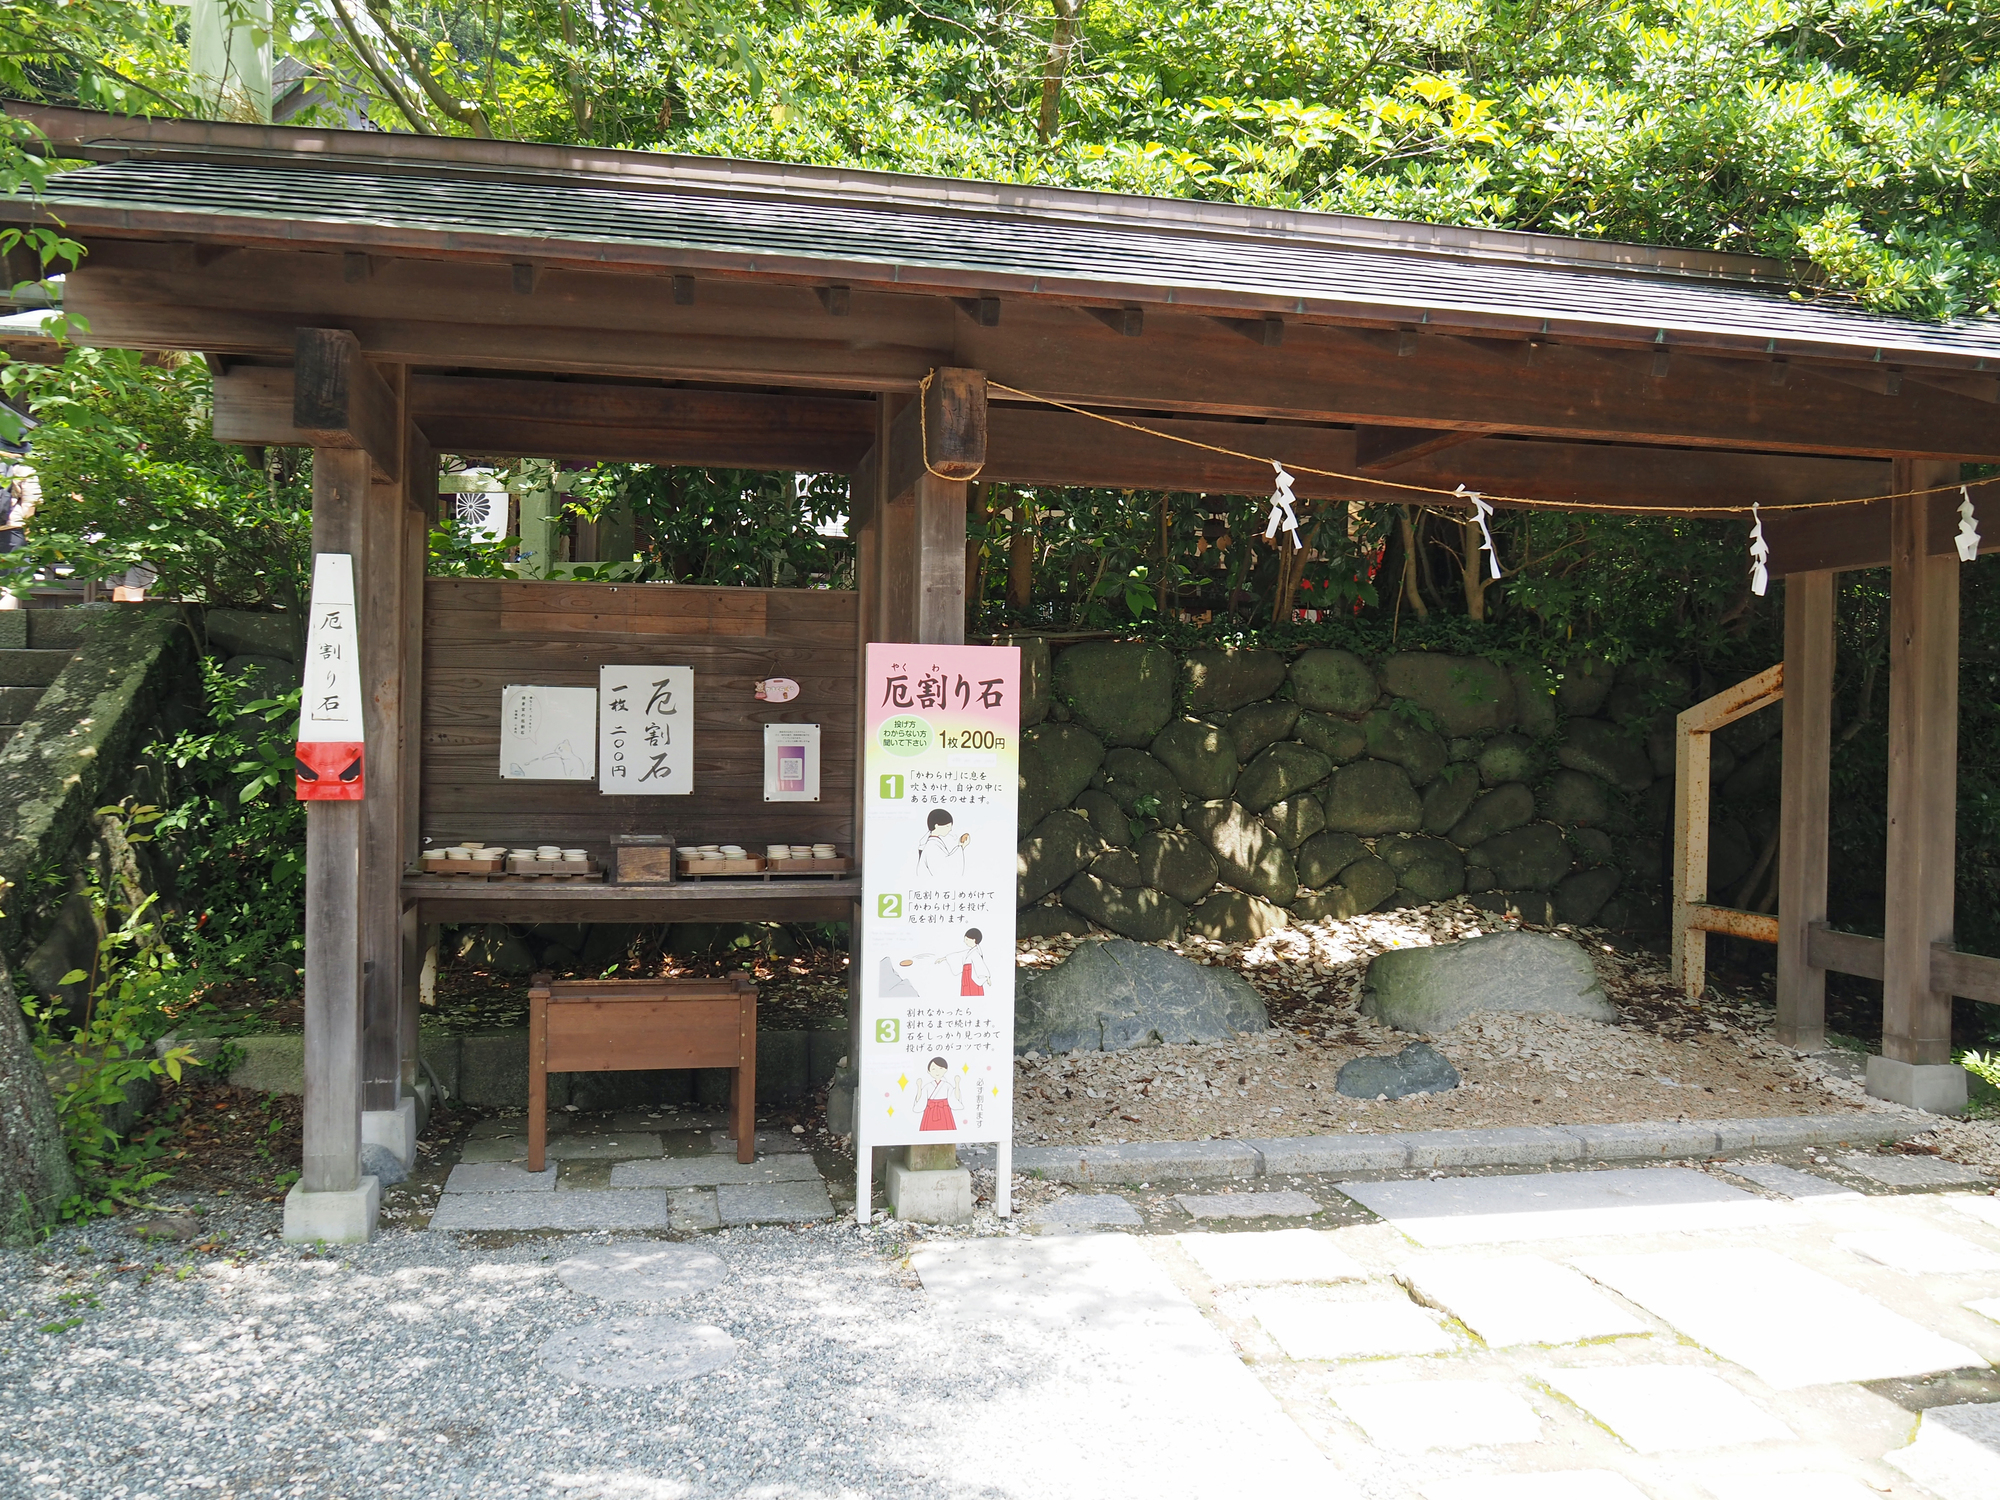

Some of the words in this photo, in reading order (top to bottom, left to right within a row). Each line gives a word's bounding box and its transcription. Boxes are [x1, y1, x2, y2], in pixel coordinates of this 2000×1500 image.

[318, 610, 343, 712] 厄割り石
[891, 662, 908, 672] やく
[931, 664, 940, 672] わ
[881, 672, 1005, 711] 厄割り石
[608, 684, 629, 713] 一枚
[894, 720, 917, 729] 投げ方
[637, 678, 678, 782] 厄割石
[883, 730, 928, 738] わからない方
[883, 738, 928, 747] 聞いて下さい
[910, 770, 988, 781] 「かわらけ」に息を
[885, 776, 896, 798] 1
[910, 782, 1003, 792] 吹きかけ、自分の中に
[910, 795, 991, 805] ある厄をのせます。
[908, 890, 996, 900] 「厄割り石」めがけて
[882, 895, 899, 917] 2
[908, 902, 990, 912] 「かわらけ」を投げ、
[908, 914, 970, 924] 厄を割ります。
[906, 1007, 973, 1018] 割れなかったら
[906, 1019, 996, 1029] 割れるまで続けます。
[880, 1019, 896, 1042] 3
[906, 1030, 1001, 1041] 石をしっかり見つめて
[906, 1043, 995, 1053] 投げるのがコツです。
[976, 1077, 984, 1129] 必ず割れます
